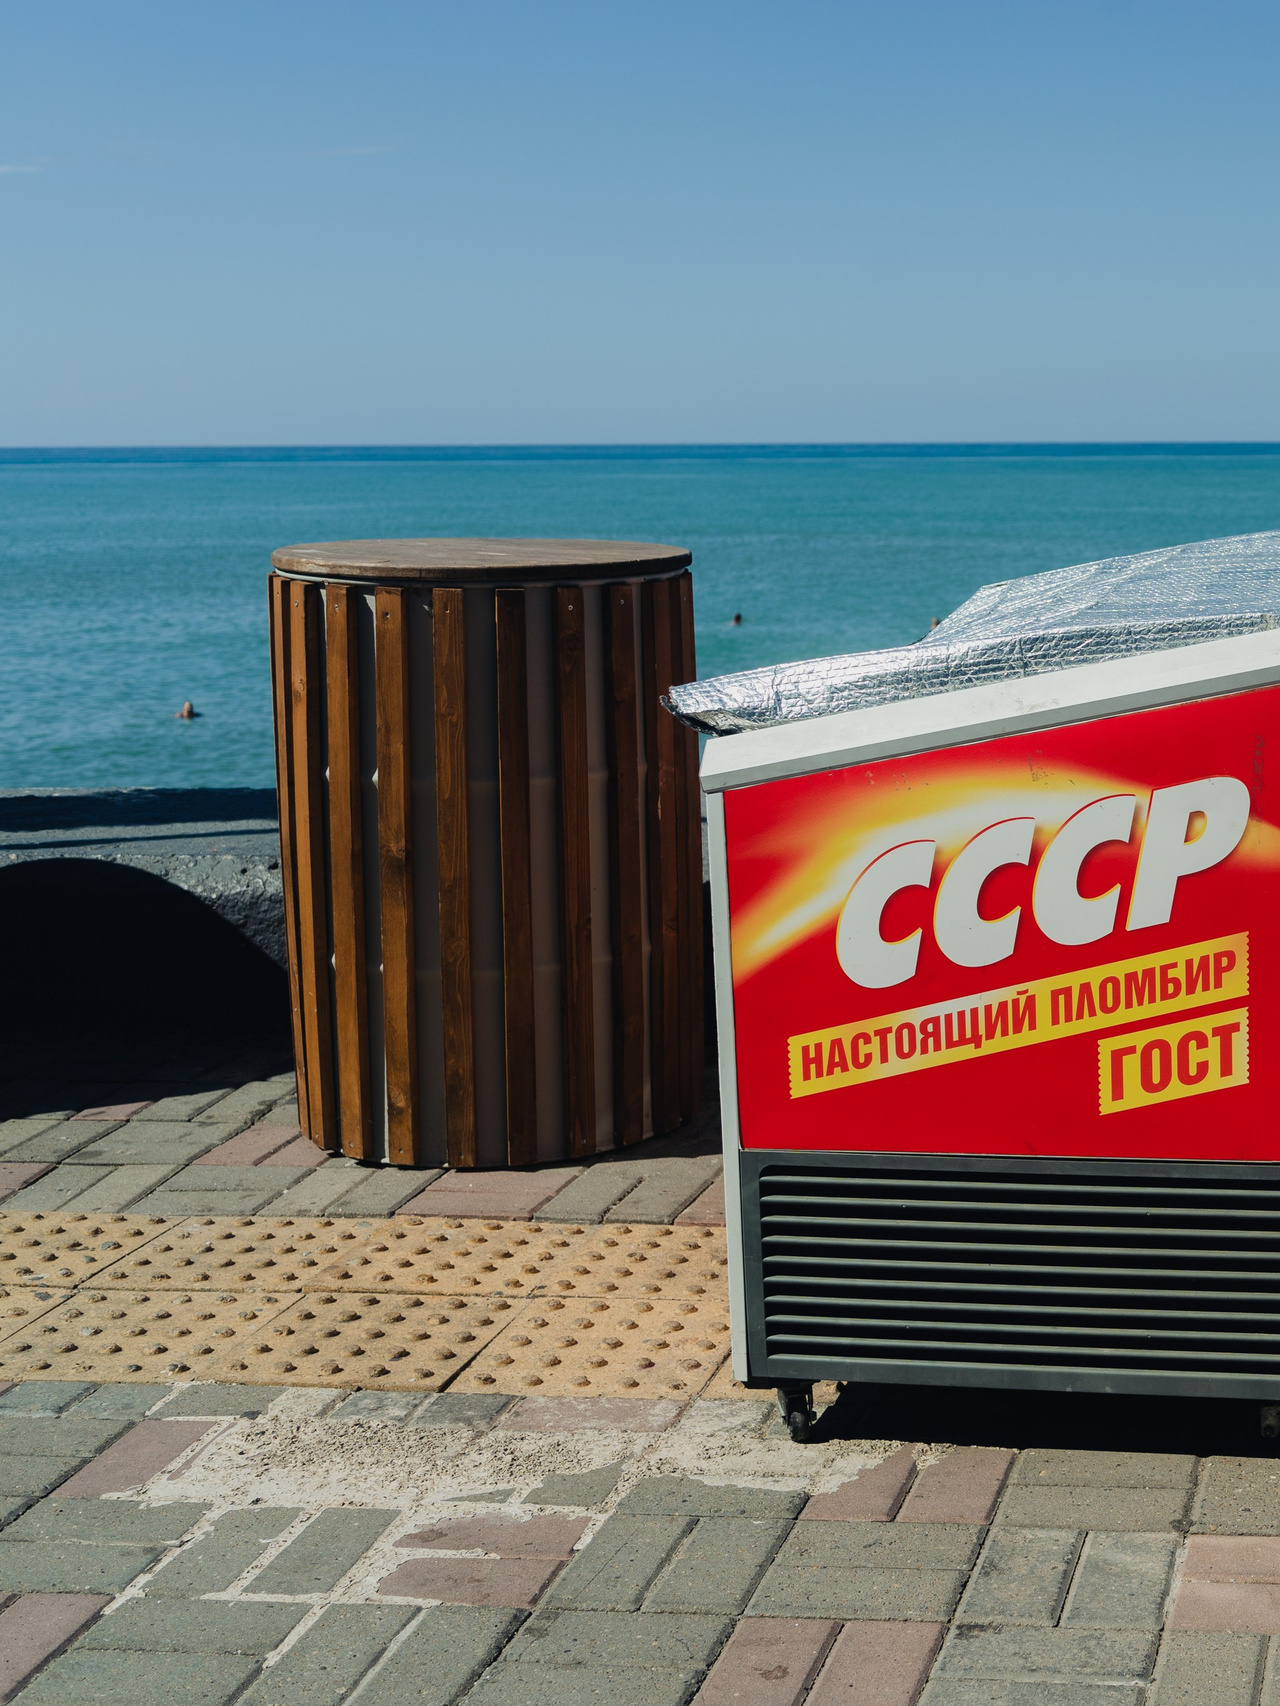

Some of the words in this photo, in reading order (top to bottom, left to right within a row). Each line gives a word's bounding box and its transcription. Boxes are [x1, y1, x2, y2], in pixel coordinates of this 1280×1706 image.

[836, 776, 1251, 989] СССР
[801, 988, 1037, 1082] НАСТОЯЩИЙ
[1050, 949, 1237, 1027] ПЛОМБИР
[1109, 1021, 1242, 1103] ГОСТ
